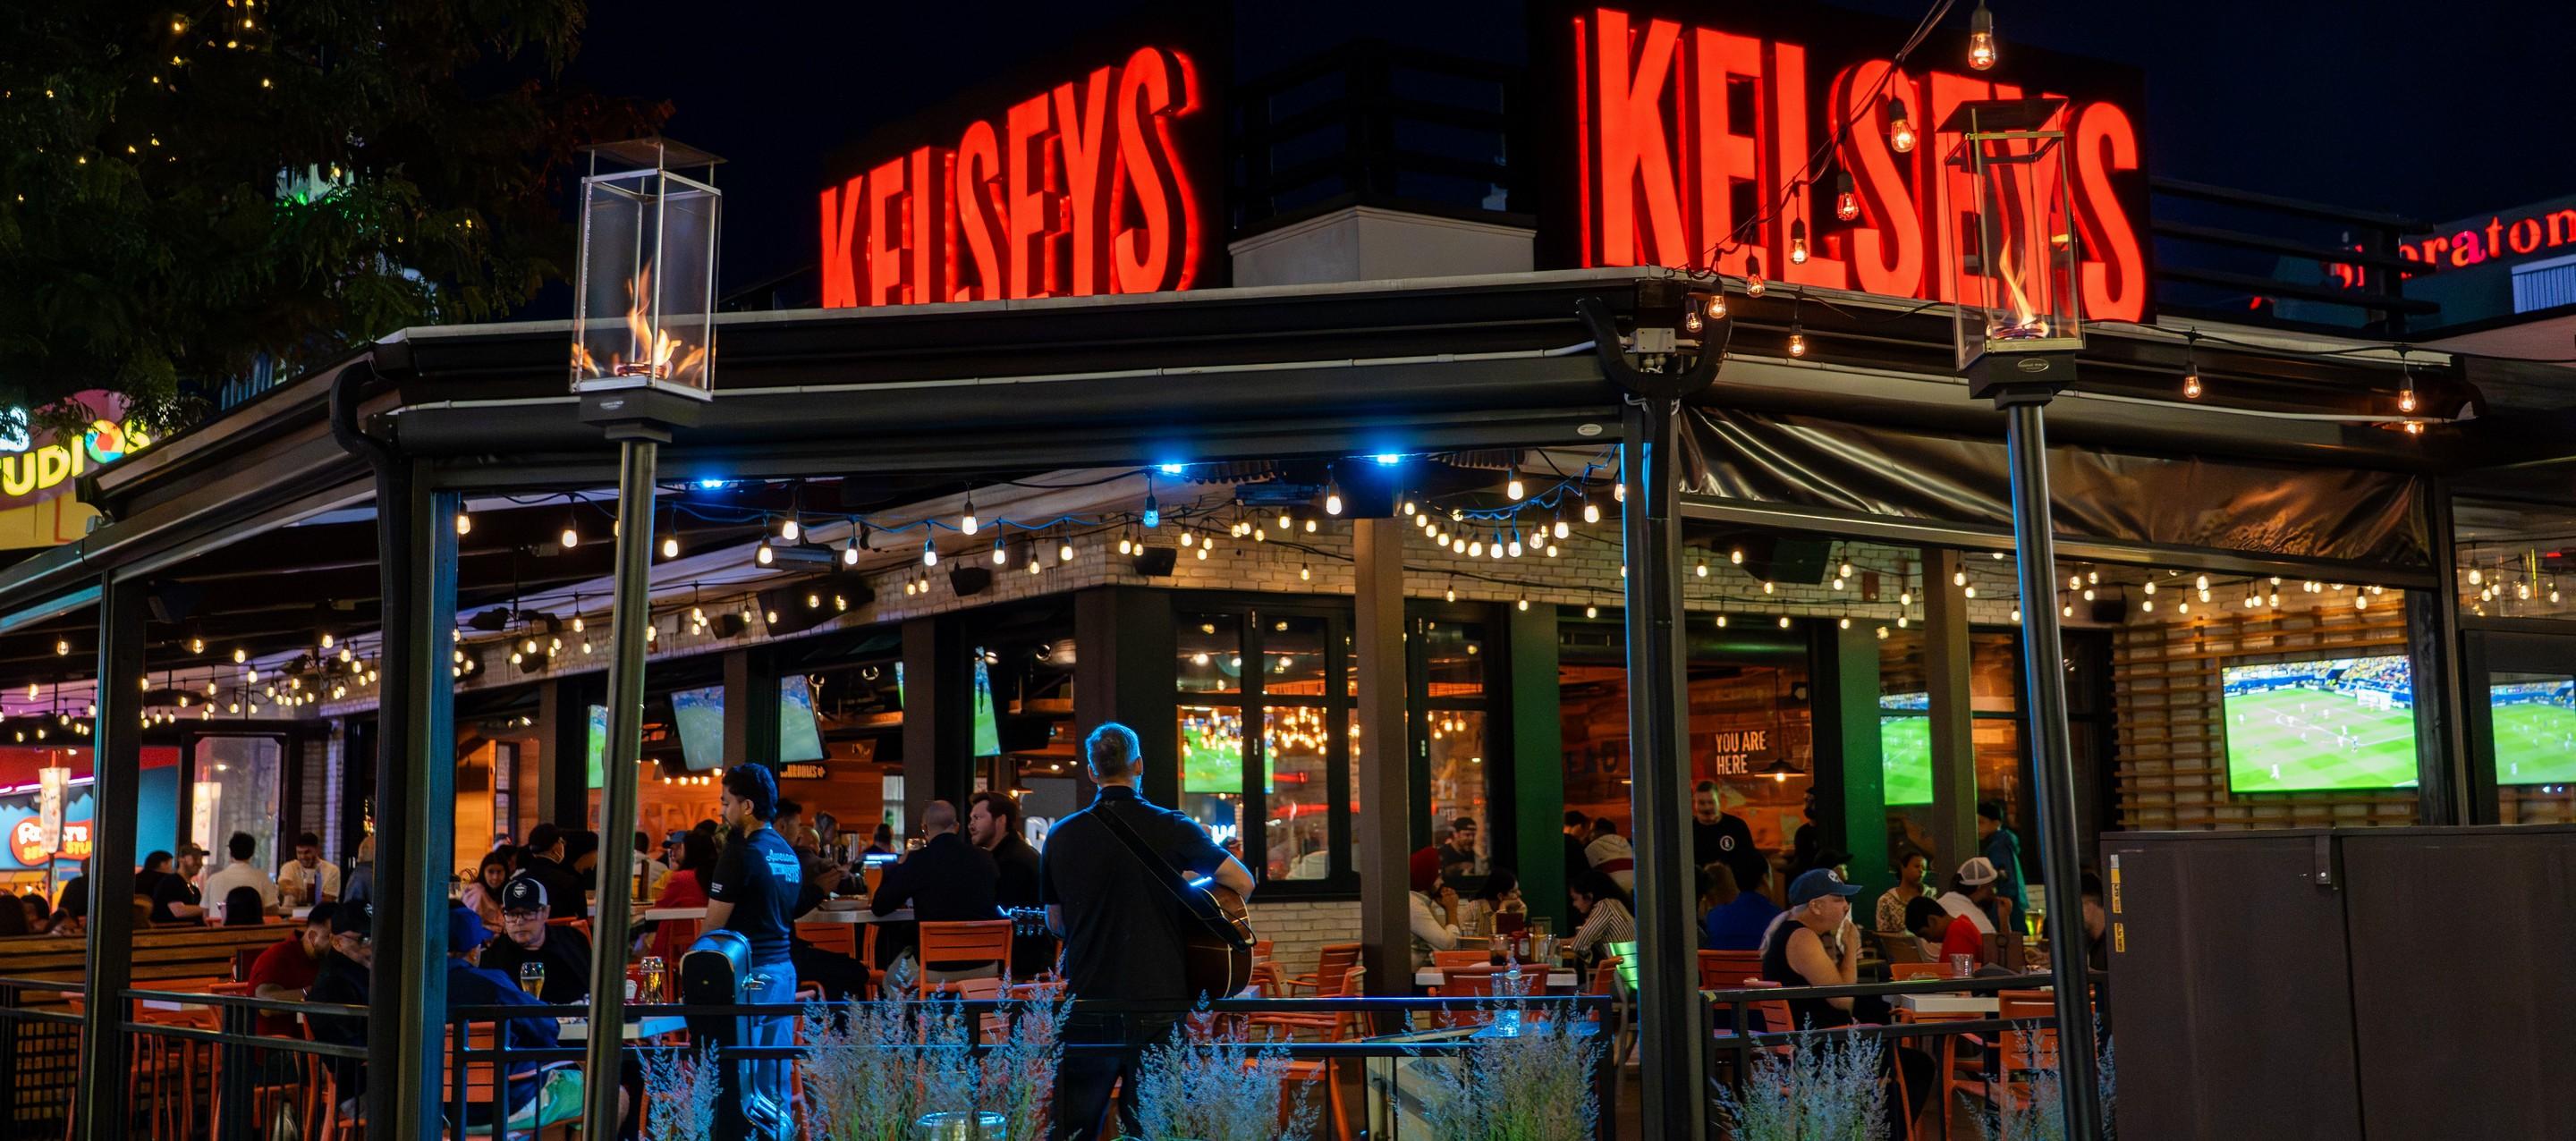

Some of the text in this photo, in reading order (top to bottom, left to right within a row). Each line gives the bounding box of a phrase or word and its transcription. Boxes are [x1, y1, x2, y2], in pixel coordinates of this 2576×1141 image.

[821, 46, 1200, 308] KELSEYS
[1576, 7, 2145, 323] KELSEYS
[1716, 731, 1767, 753] YOU ARE
[1716, 754, 1749, 775] HERE
